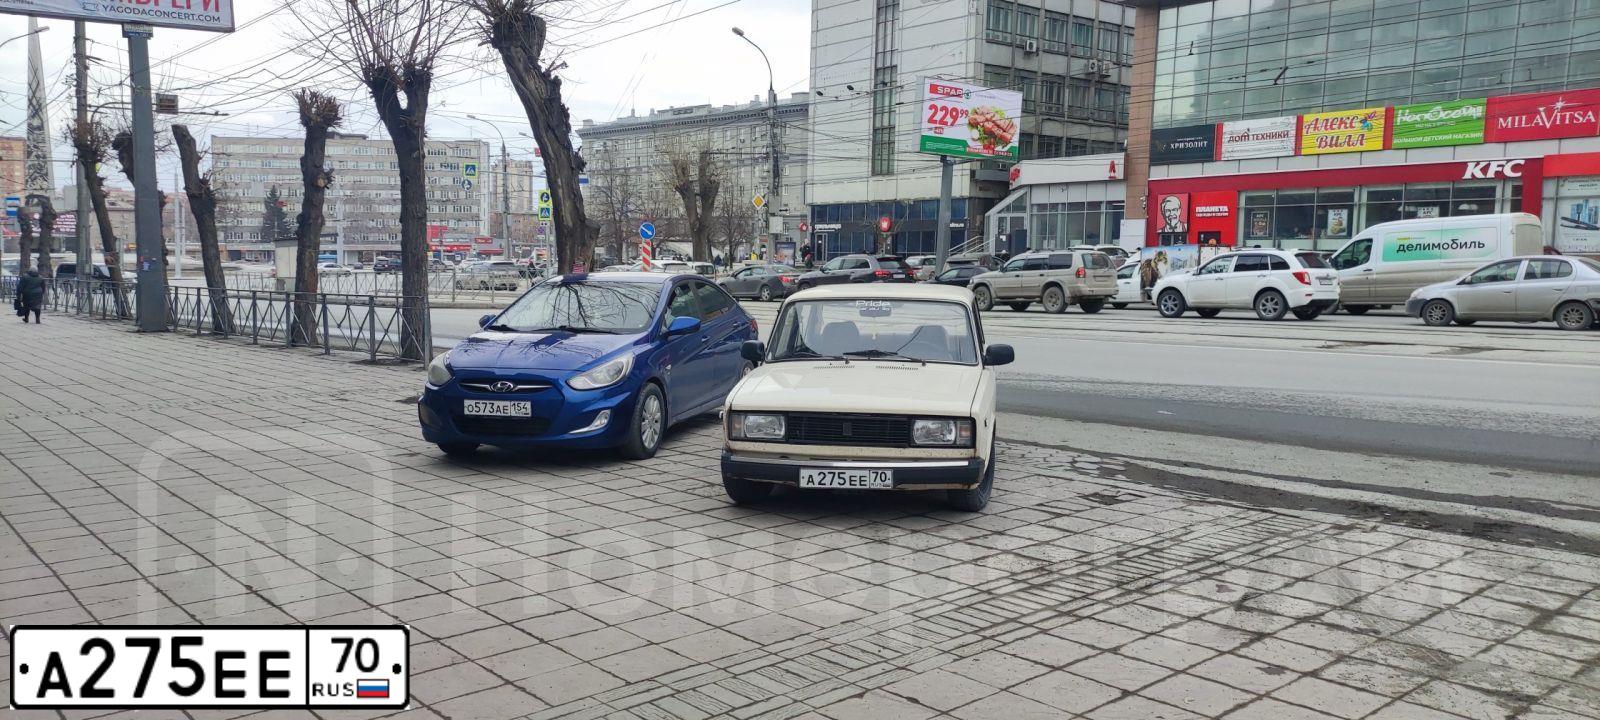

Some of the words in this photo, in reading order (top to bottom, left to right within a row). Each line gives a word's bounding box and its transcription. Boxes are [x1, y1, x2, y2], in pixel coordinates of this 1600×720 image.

[102, 4, 221, 23] YAGODACONCERT.COM
[928, 104, 959, 126] 229
[960, 109, 969, 118] 99
[1498, 106, 1596, 129] MILAVITSA
[1252, 130, 1290, 141] ТЕХНИКИ
[1170, 141, 1208, 149] ХРИЗОЛИТ
[1462, 159, 1526, 179] KFC
[1396, 239, 1485, 253] делимобиль
[806, 471, 867, 487] А275ЕЕ
[872, 471, 887, 483] 70
